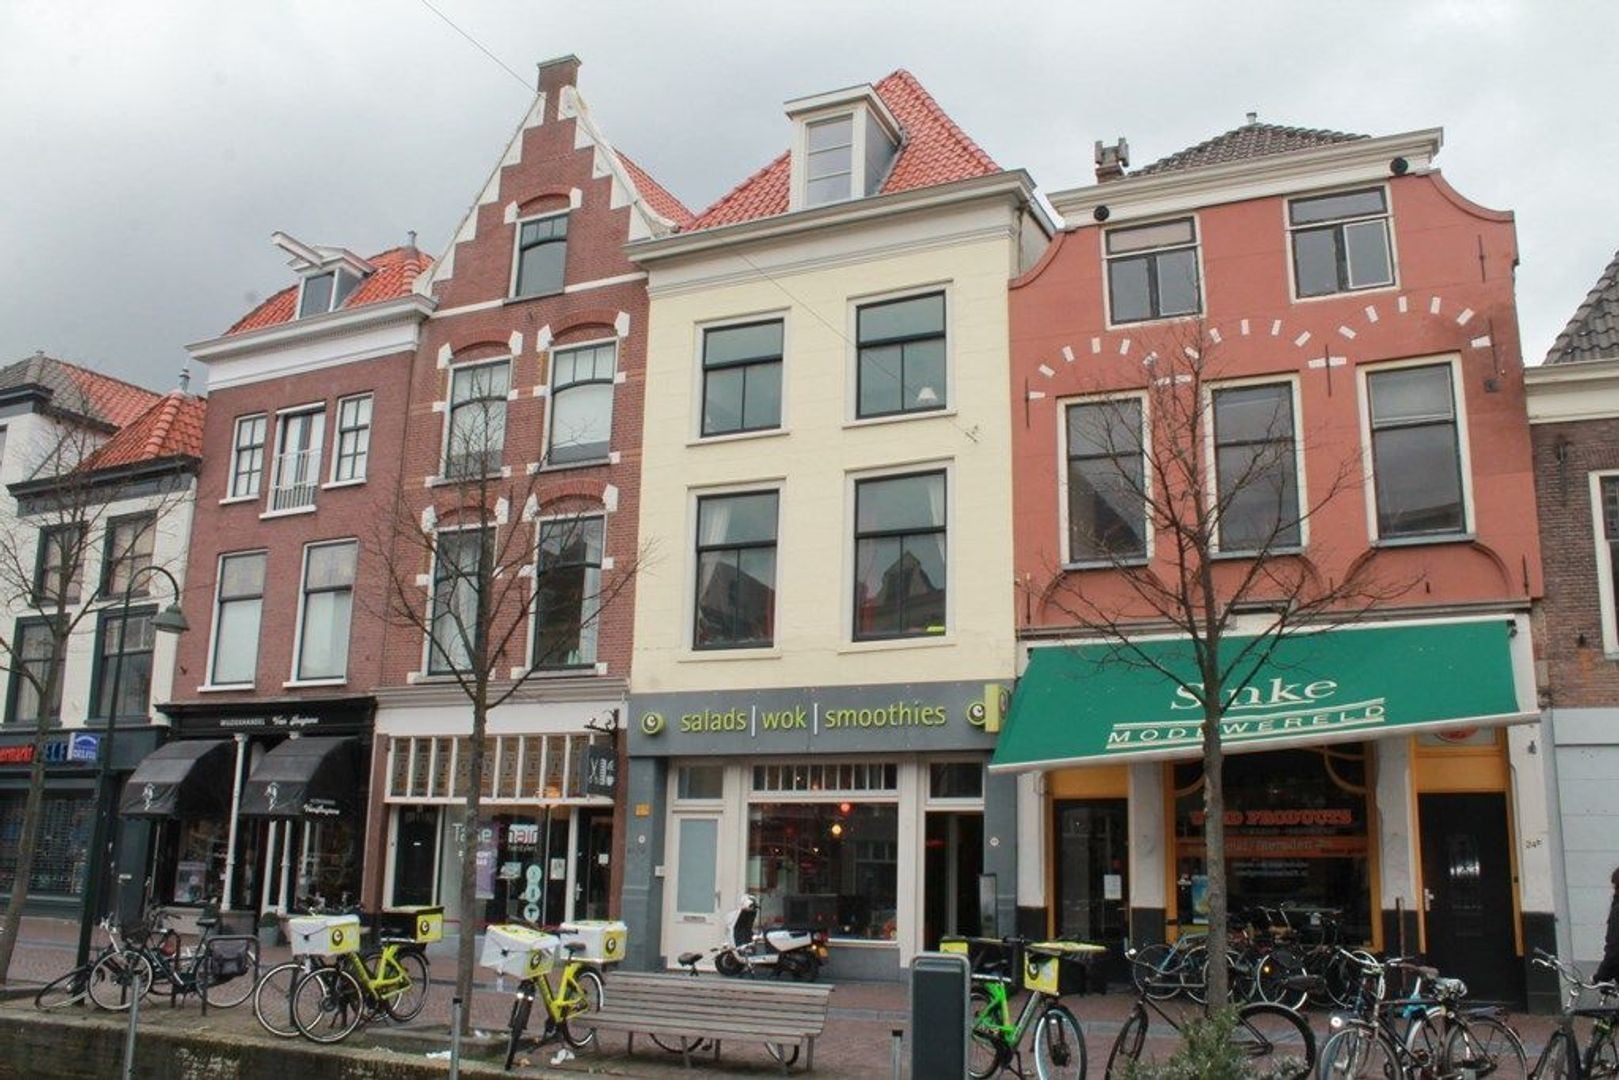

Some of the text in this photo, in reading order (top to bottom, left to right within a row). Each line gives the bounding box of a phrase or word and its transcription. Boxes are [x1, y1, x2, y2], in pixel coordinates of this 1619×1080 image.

[1171, 676, 1338, 710] Snke
[681, 701, 946, 732] salads wok smoothies
